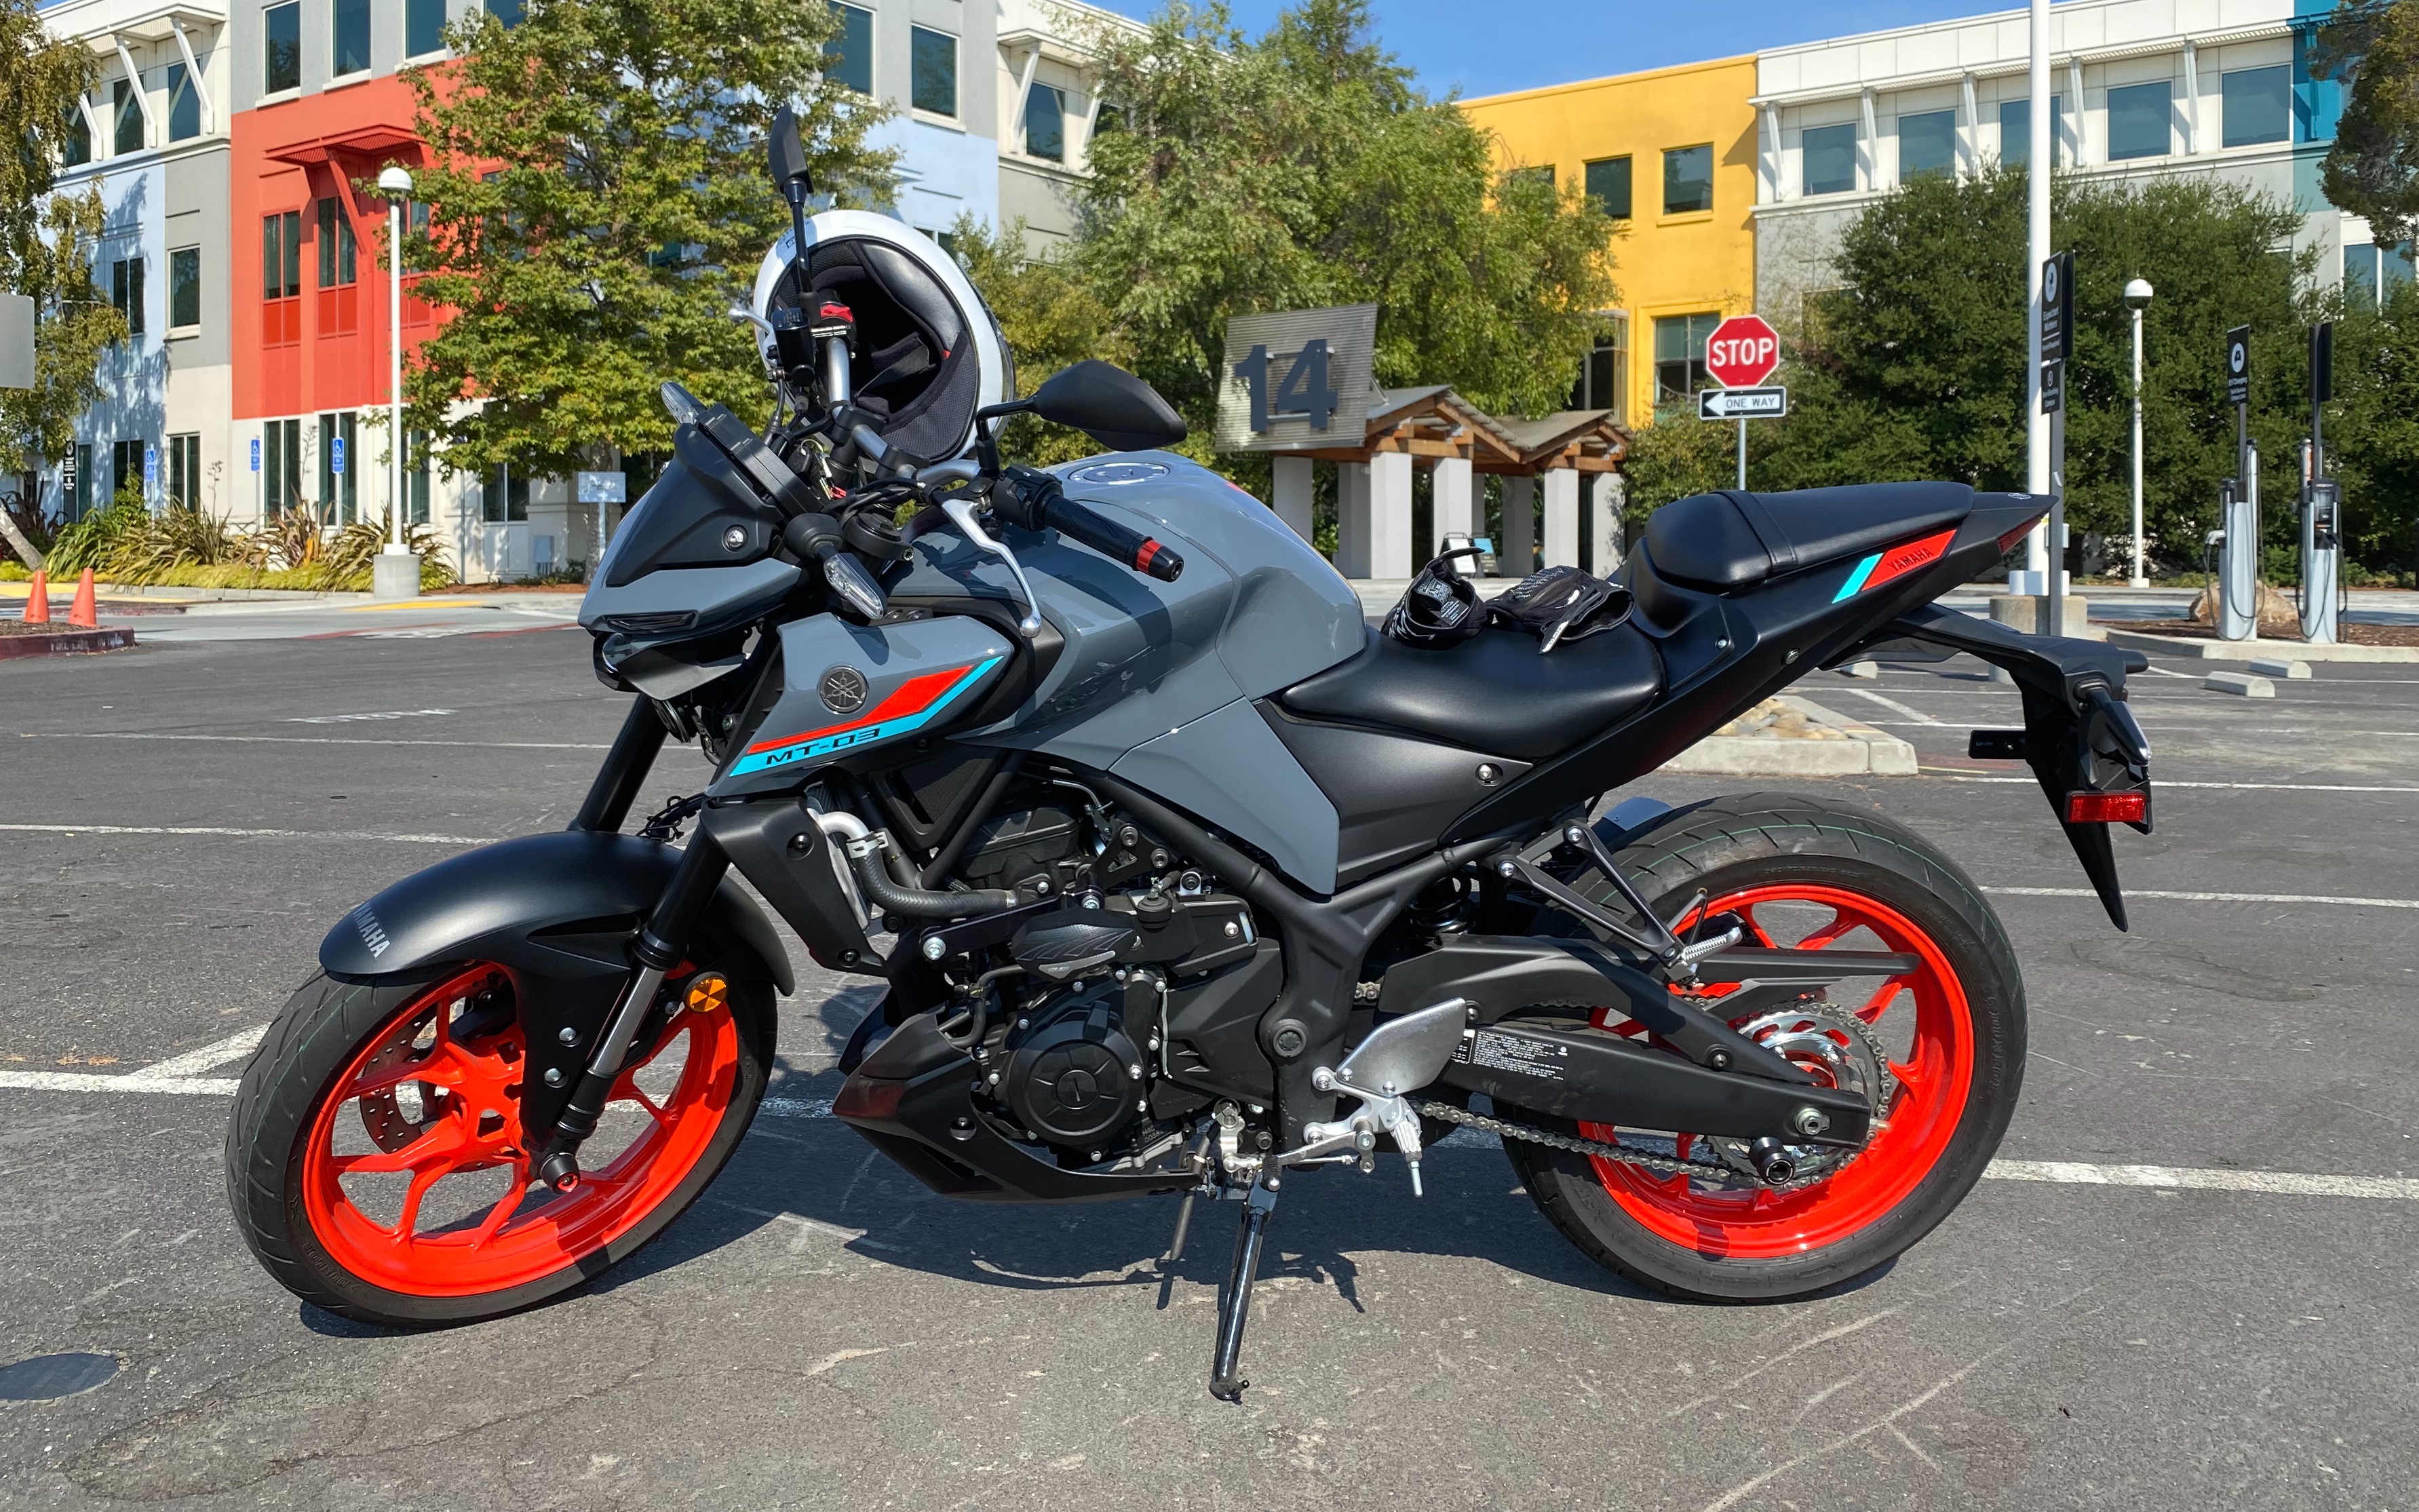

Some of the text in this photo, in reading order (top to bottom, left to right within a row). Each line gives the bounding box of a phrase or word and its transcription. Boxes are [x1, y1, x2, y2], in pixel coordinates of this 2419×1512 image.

[1712, 337, 1774, 367] STOP
[1235, 338, 1338, 433] 14
[1726, 396, 1776, 408] ONE WAY
[1886, 547, 1935, 571] YAMAHA
[766, 727, 881, 766] MT-03
[353, 902, 391, 958] YAMAHA
[303, 1243, 351, 1288] DUNLOP
